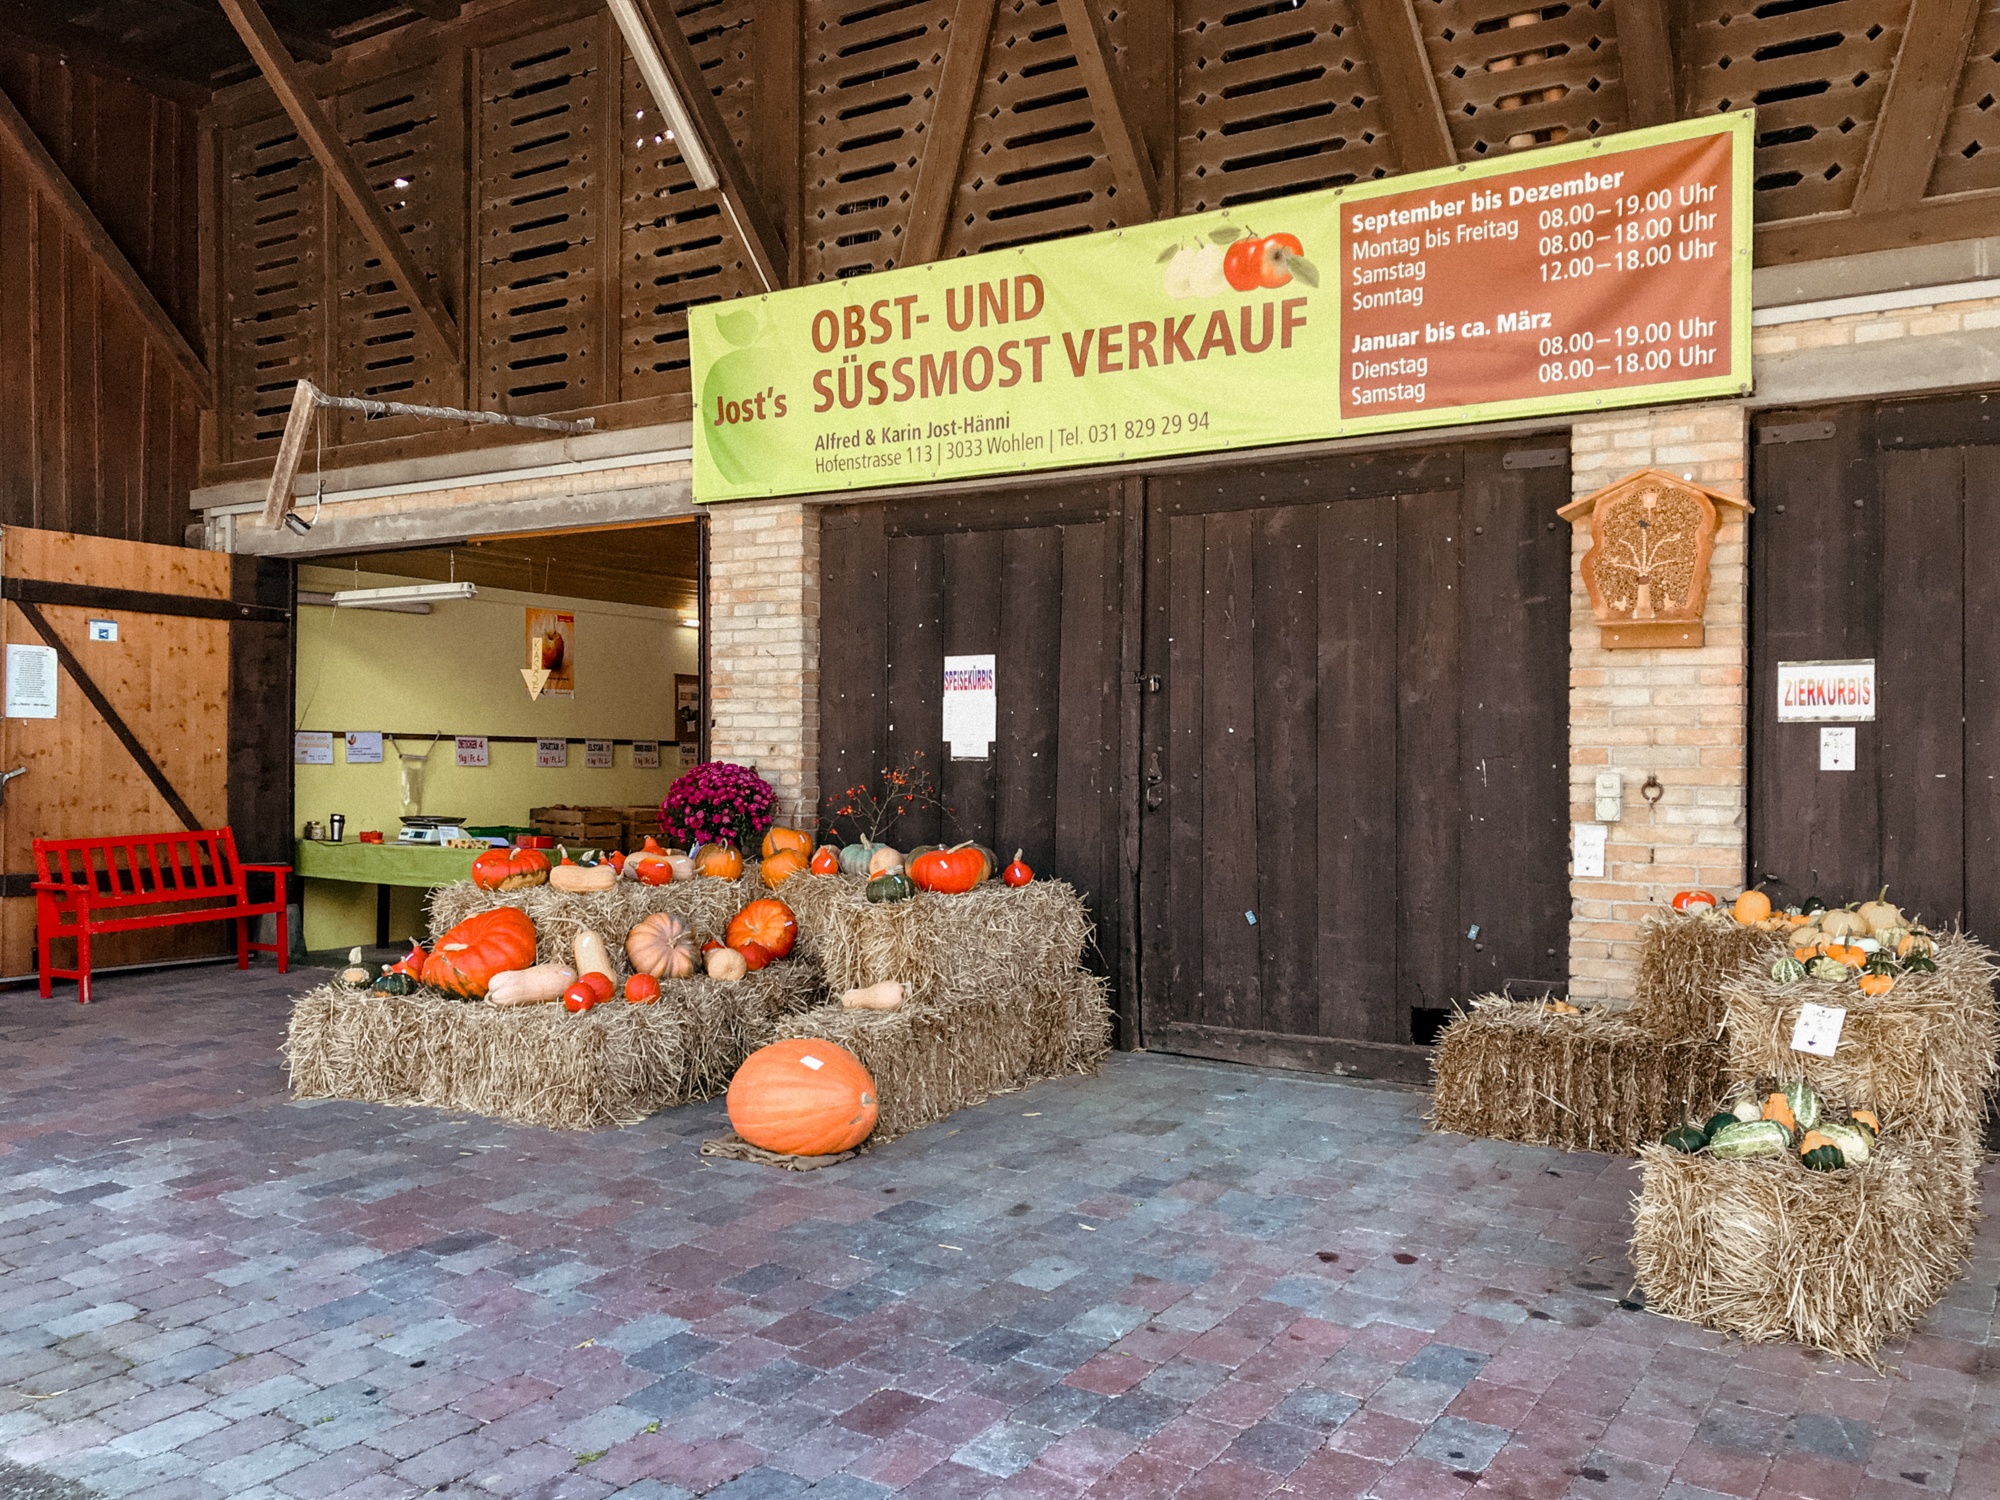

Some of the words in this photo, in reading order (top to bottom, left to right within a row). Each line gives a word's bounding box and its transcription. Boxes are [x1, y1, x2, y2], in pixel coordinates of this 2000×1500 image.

[1352, 199, 1466, 234] September
[1471, 189, 1503, 213] bis
[1509, 171, 1625, 206] Dezember
[1679, 182, 1718, 207] Uhr
[1679, 211, 1718, 234] Uhr
[1352, 236, 1420, 261] Montag
[1425, 227, 1451, 249] bis
[1456, 219, 1519, 244] Freitag
[1678, 239, 1718, 262] Uhr
[1352, 260, 1426, 286] Samstag
[1352, 286, 1424, 311] Sonntag
[811, 294, 930, 354] OBST-
[945, 273, 1045, 332] UND
[1351, 330, 1420, 354] Januar
[1425, 321, 1456, 344] bis
[1460, 321, 1491, 339] ca.
[1496, 309, 1553, 334] März
[1678, 316, 1717, 340] Uhr
[812, 335, 1051, 413] SÜSSMOST
[1061, 296, 1308, 378] VERKAUF
[1678, 345, 1717, 367] Uhr
[1351, 357, 1428, 381] Dienstag
[713, 386, 788, 427] Jost's
[1351, 382, 1426, 406] Samstag
[814, 429, 860, 452] Alfred
[865, 428, 876, 446] &
[882, 423, 922, 444] Karin
[926, 410, 1010, 439] Jost-Hänni
[815, 452, 902, 473] Hofenstrasse
[907, 445, 932, 463] 113
[947, 439, 982, 460] 3033
[986, 432, 1044, 455] Wohlen
[1058, 426, 1083, 446] Tel.
[1088, 423, 1116, 443] 031
[1124, 418, 1155, 439] 829
[1161, 414, 1182, 435] 29
[1188, 411, 1209, 432] 94
